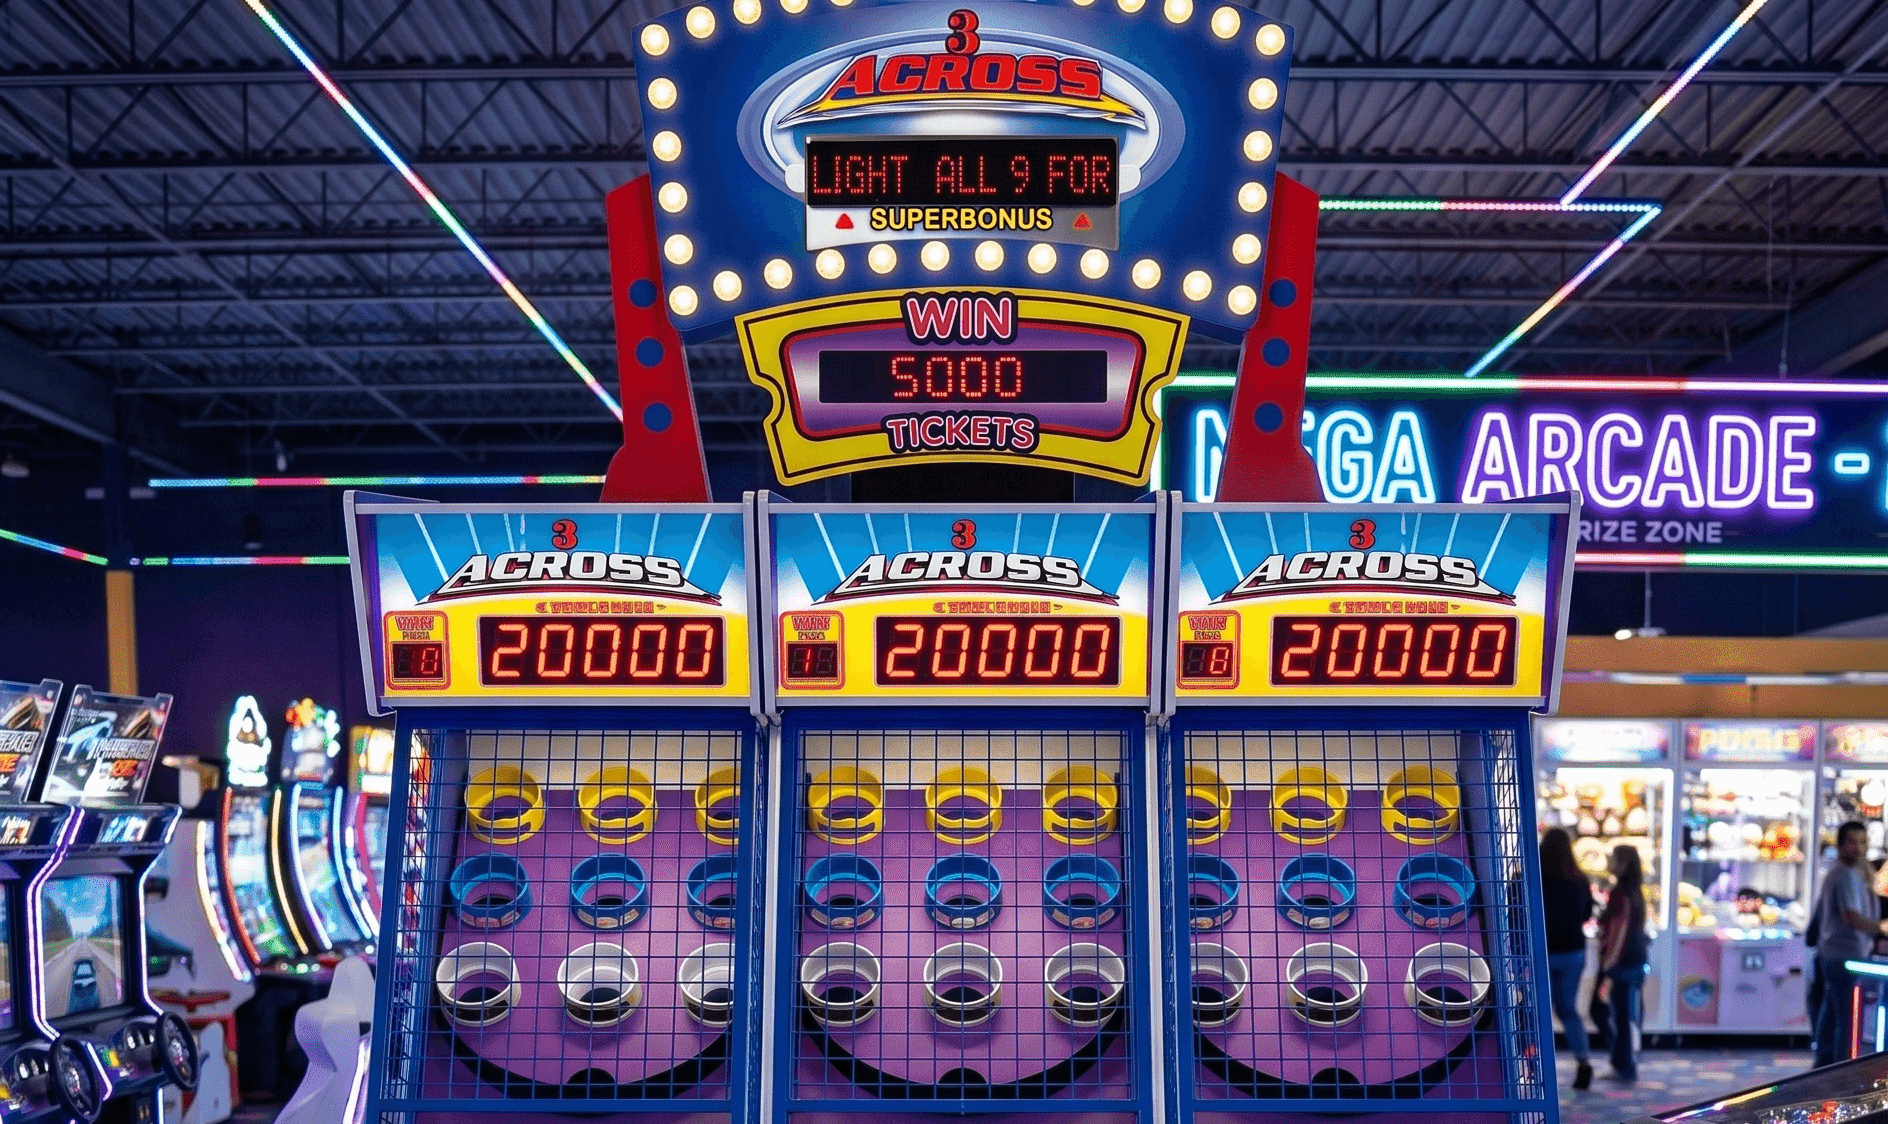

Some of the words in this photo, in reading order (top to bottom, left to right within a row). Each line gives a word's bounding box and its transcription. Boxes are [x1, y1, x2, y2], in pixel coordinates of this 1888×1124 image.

[946, 9, 980, 54] 3
[828, 54, 1102, 99] ACROSS
[813, 155, 908, 194] LIGHT
[936, 155, 997, 194] ALL
[1011, 155, 1030, 194] 9
[1049, 155, 1110, 194] FOR
[870, 207, 1053, 230] SUPERBONUS
[907, 297, 1012, 339] WIN
[891, 356, 1022, 398] 5000
[886, 415, 1035, 449] TICKETS
[1196, 410, 1436, 503] GA
[1462, 412, 1816, 509] ARCADE
[551, 519, 578, 549] 3
[950, 519, 977, 549] 3
[1349, 519, 1376, 549] 3
[1578, 520, 1637, 542] RIZE
[1644, 520, 1723, 543] ZONE
[441, 551, 685, 589] ACROSS
[837, 551, 1083, 589] ACROSS
[1237, 551, 1480, 589] ACROSS
[491, 623, 715, 678] 20000
[885, 623, 1112, 678] 20000
[1210, 647, 1229, 674] 8
[1280, 623, 1508, 678] 20000
